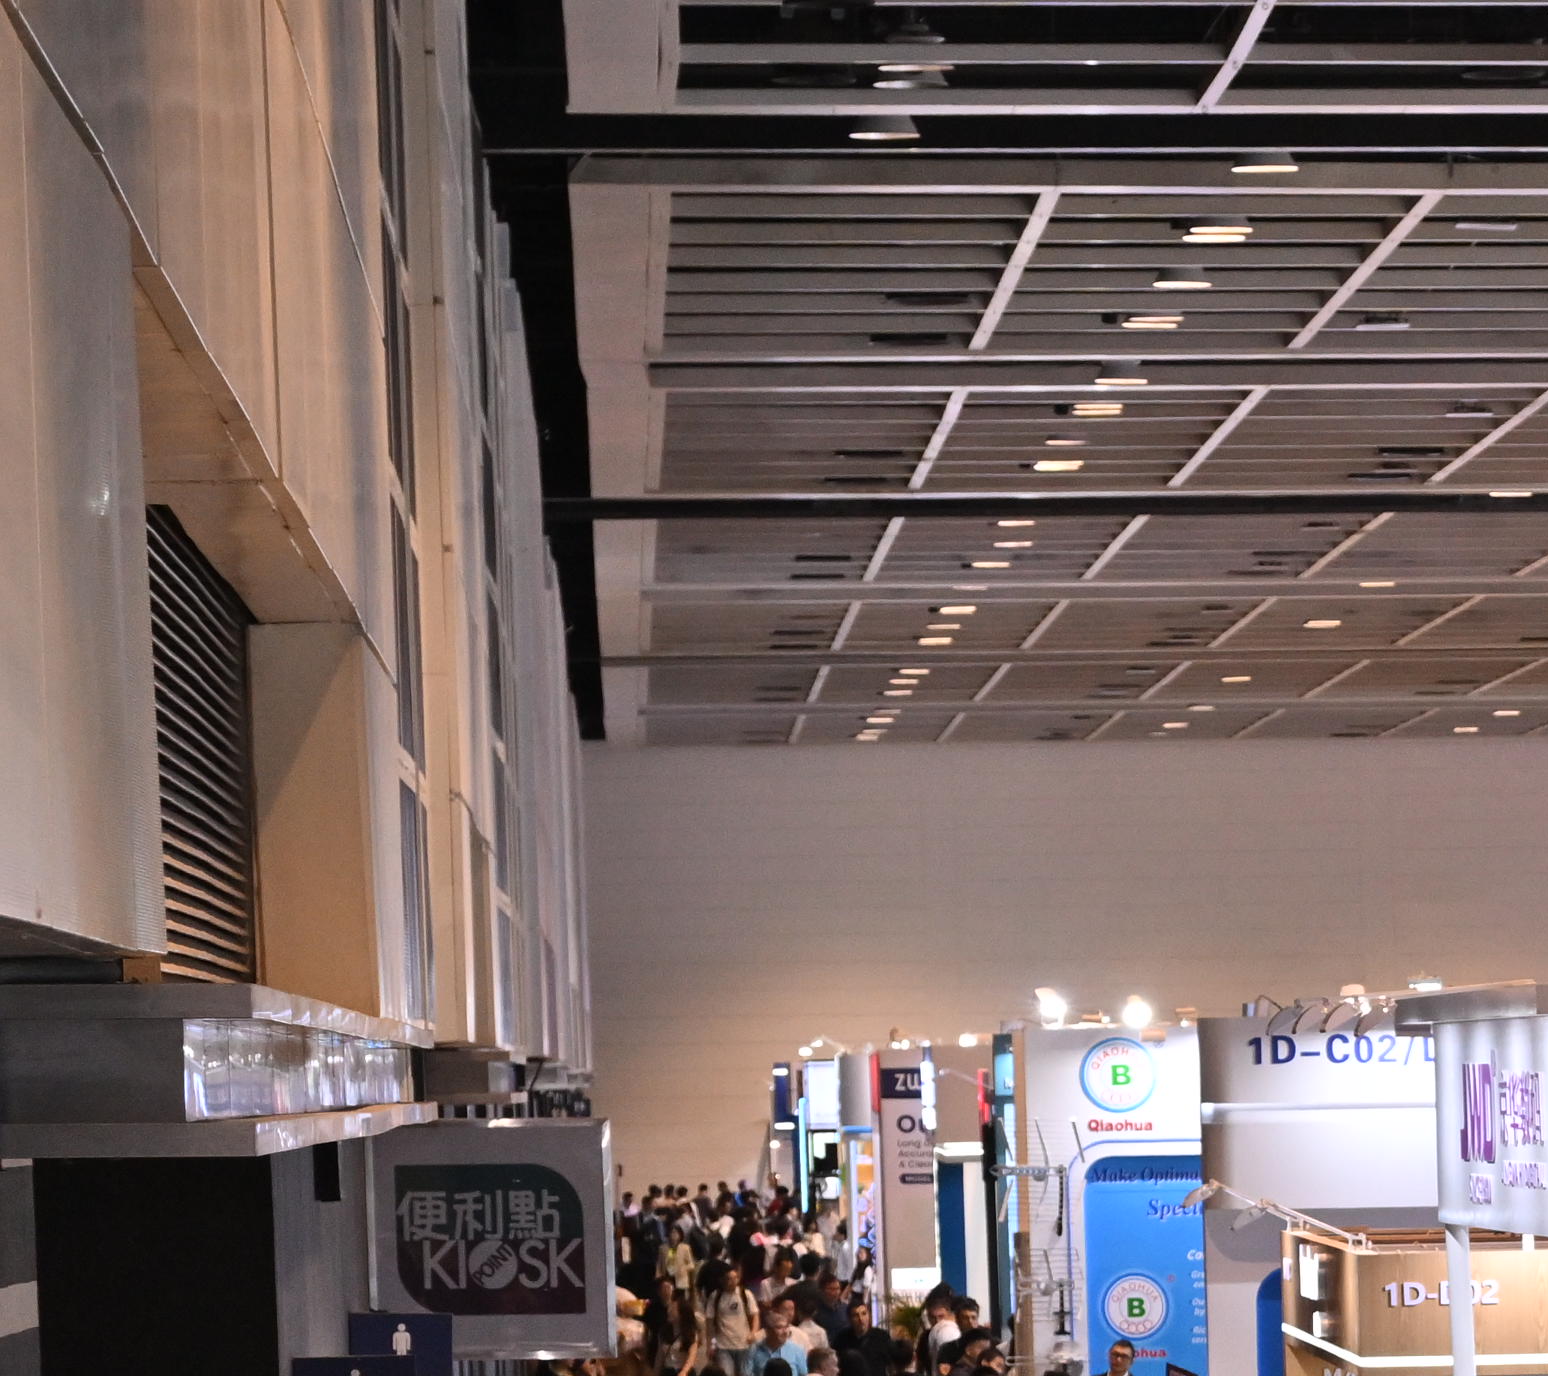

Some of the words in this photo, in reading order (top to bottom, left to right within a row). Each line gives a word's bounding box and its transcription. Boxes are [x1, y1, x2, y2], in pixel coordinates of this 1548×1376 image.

[1111, 1064, 1132, 1086] B
[1087, 1118, 1154, 1133] Qiaohua
[396, 1189, 560, 1242] 便利點
[422, 1238, 585, 1290] KIOSK
[1384, 1279, 1500, 1307] 1D-02
[1126, 1297, 1147, 1318] B
